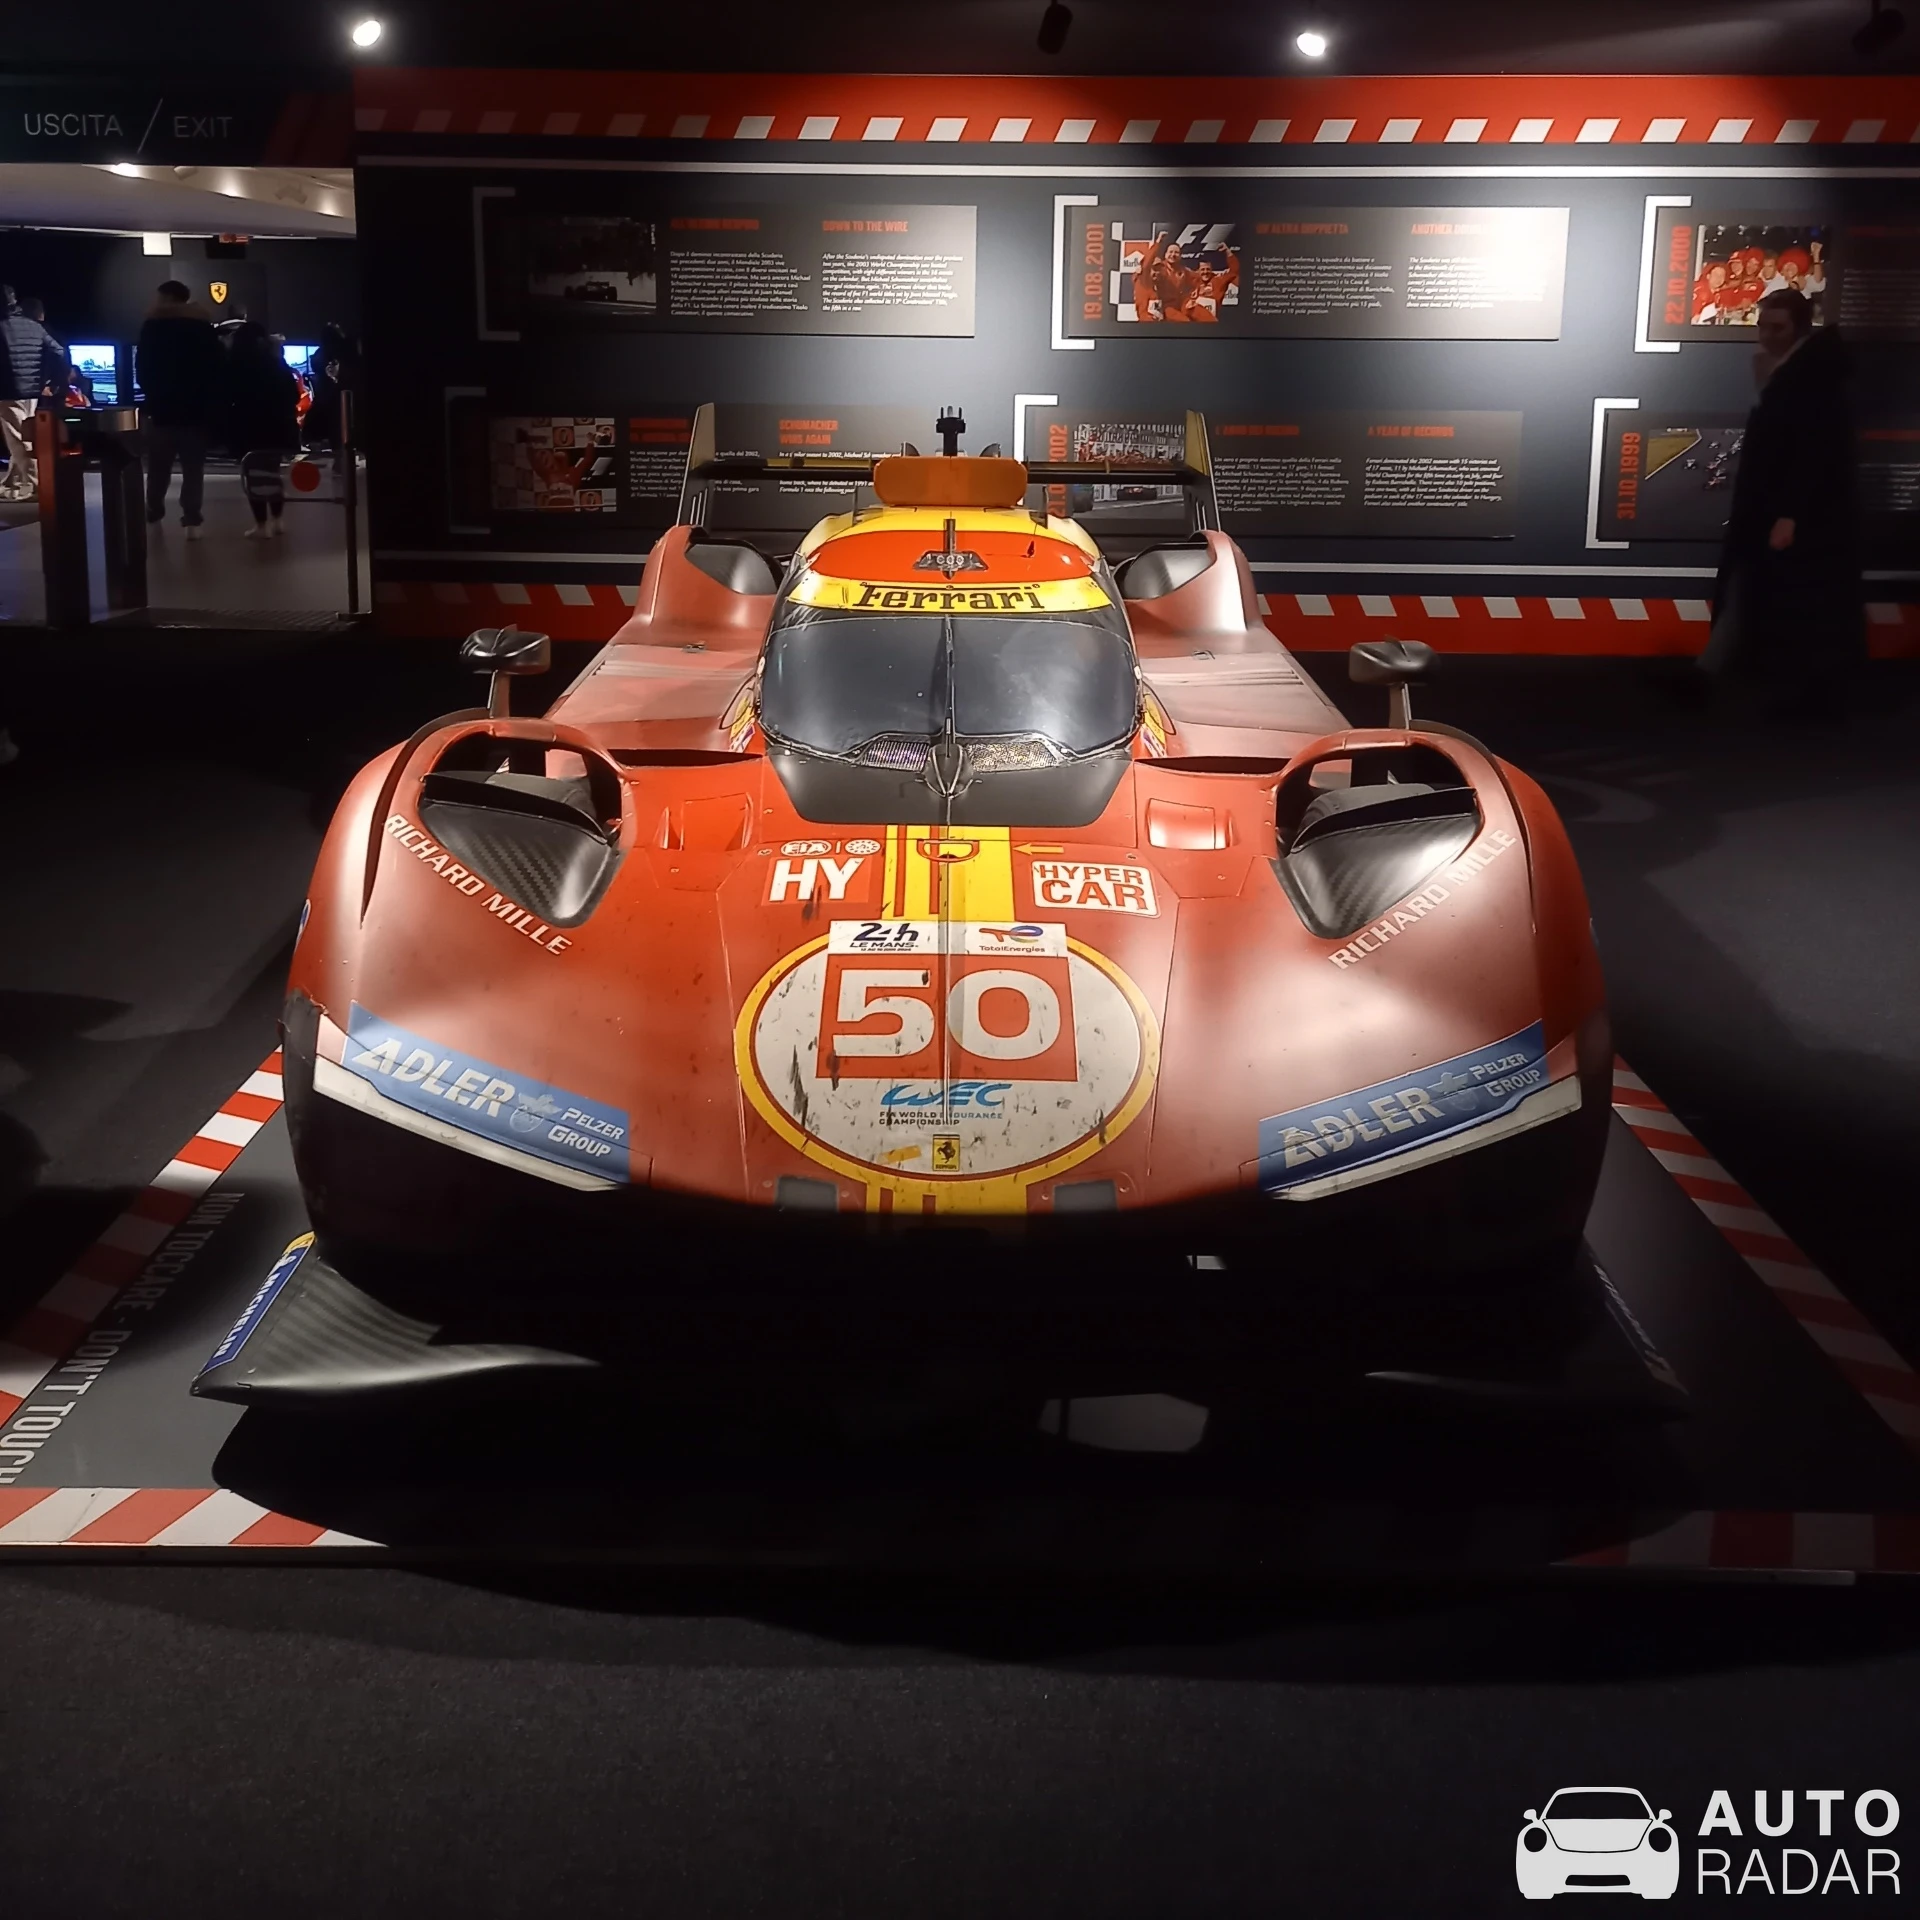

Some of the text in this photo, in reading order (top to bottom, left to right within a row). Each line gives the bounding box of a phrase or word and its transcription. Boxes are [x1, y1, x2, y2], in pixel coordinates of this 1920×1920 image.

[24, 113, 233, 138] USCITA EXIT
[866, 220, 882, 232] THE
[1084, 224, 1105, 320] 19.08.2001
[1664, 225, 1693, 325] 22.10.2000
[1616, 431, 1641, 520] 31.10.1999
[852, 584, 1045, 610] Ferrari
[385, 814, 573, 955] RICHARD MILLE
[770, 858, 865, 901] HY
[1039, 865, 1144, 885] HYPER
[1041, 880, 1146, 910] CAR
[1328, 829, 1517, 970] RICHARD MILLE
[979, 945, 1045, 953] TotalEnergies
[832, 969, 1061, 1061] 50
[352, 1037, 515, 1118] ADLER
[1468, 1052, 1528, 1080] PELZER
[1485, 1069, 1542, 1097] GROUP
[880, 1082, 1013, 1106] WEC
[548, 1125, 612, 1157] GROUP
[560, 1107, 625, 1140] PELZER
[1278, 1086, 1446, 1169] ADLER
[186, 1193, 245, 1225] NON
[113, 1230, 214, 1310] TOCCARE
[213, 1272, 281, 1358] MICHELIN
[43, 1331, 132, 1395] DON'T
